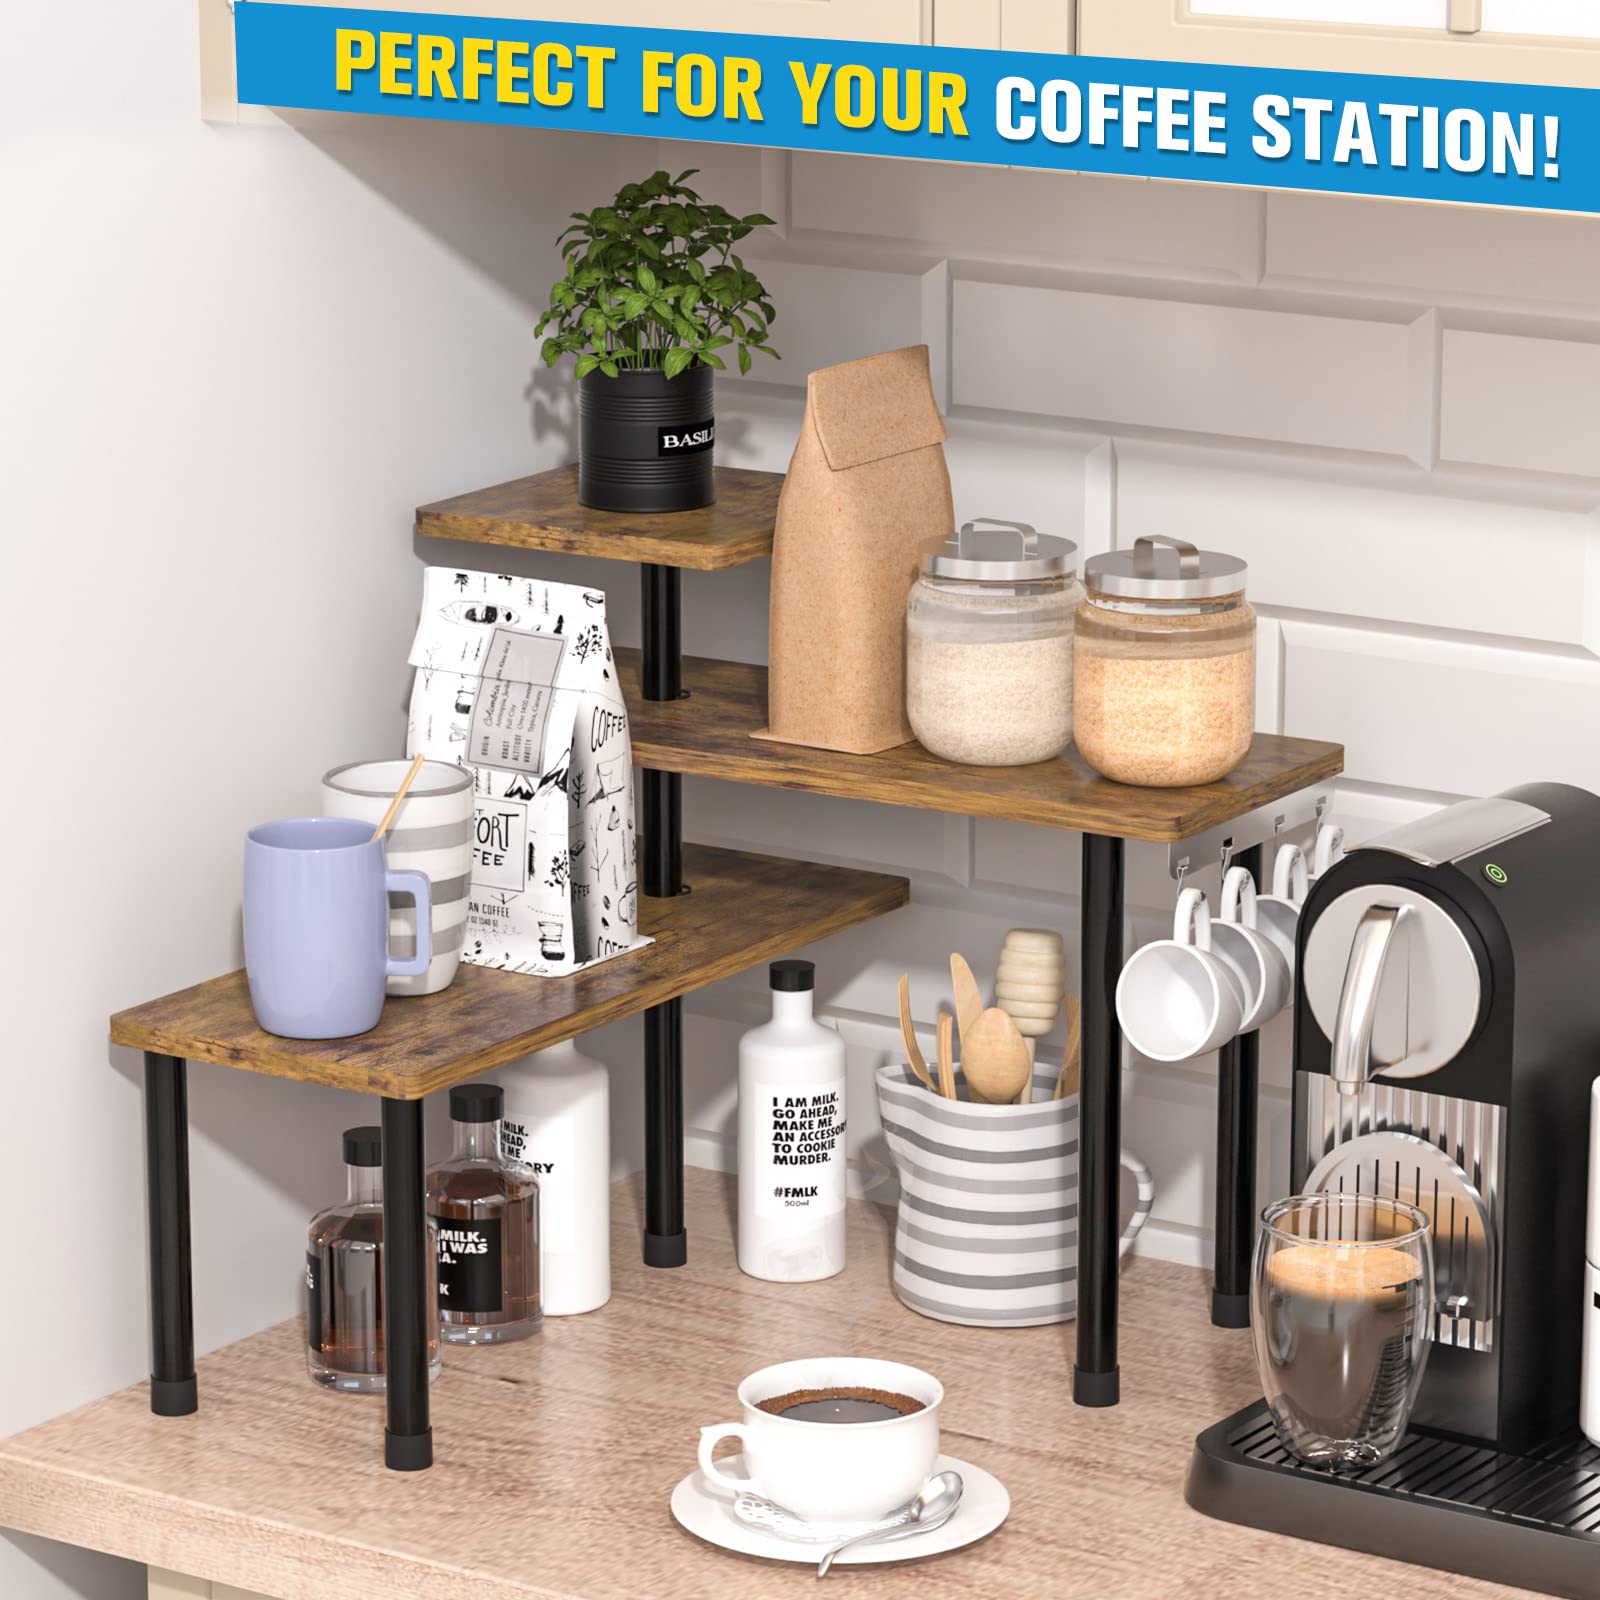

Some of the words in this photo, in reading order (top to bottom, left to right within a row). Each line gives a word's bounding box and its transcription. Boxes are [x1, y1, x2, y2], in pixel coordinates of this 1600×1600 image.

[483, 684, 500, 727] Colombia
[591, 705, 626, 752] COFFEE
[501, 741, 510, 759] ROAST
[512, 734, 522, 761] ALTITUDE
[523, 739, 532, 763] VARIETY
[474, 813, 519, 852] ORT
[482, 903, 510, 918] COFFEE
[772, 1096, 778, 1107] I
[784, 1097, 807, 1108] AM
[811, 1092, 839, 1107] MILK.
[772, 1108, 795, 1119] GO
[799, 1104, 838, 1119] AHEAD,
[772, 1120, 814, 1130] MAKE
[817, 1116, 833, 1129] ME
[501, 1131, 526, 1150] HEAD,
[772, 1131, 795, 1142] AN
[507, 1145, 521, 1159] ME
[772, 1142, 792, 1153] TO
[796, 1138, 836, 1153] COOKIE
[772, 1152, 831, 1165] MURDER.
[773, 1186, 818, 1198] #FMLK
[784, 1199, 809, 1207] 500ml
[449, 1242, 488, 1254] WAS
